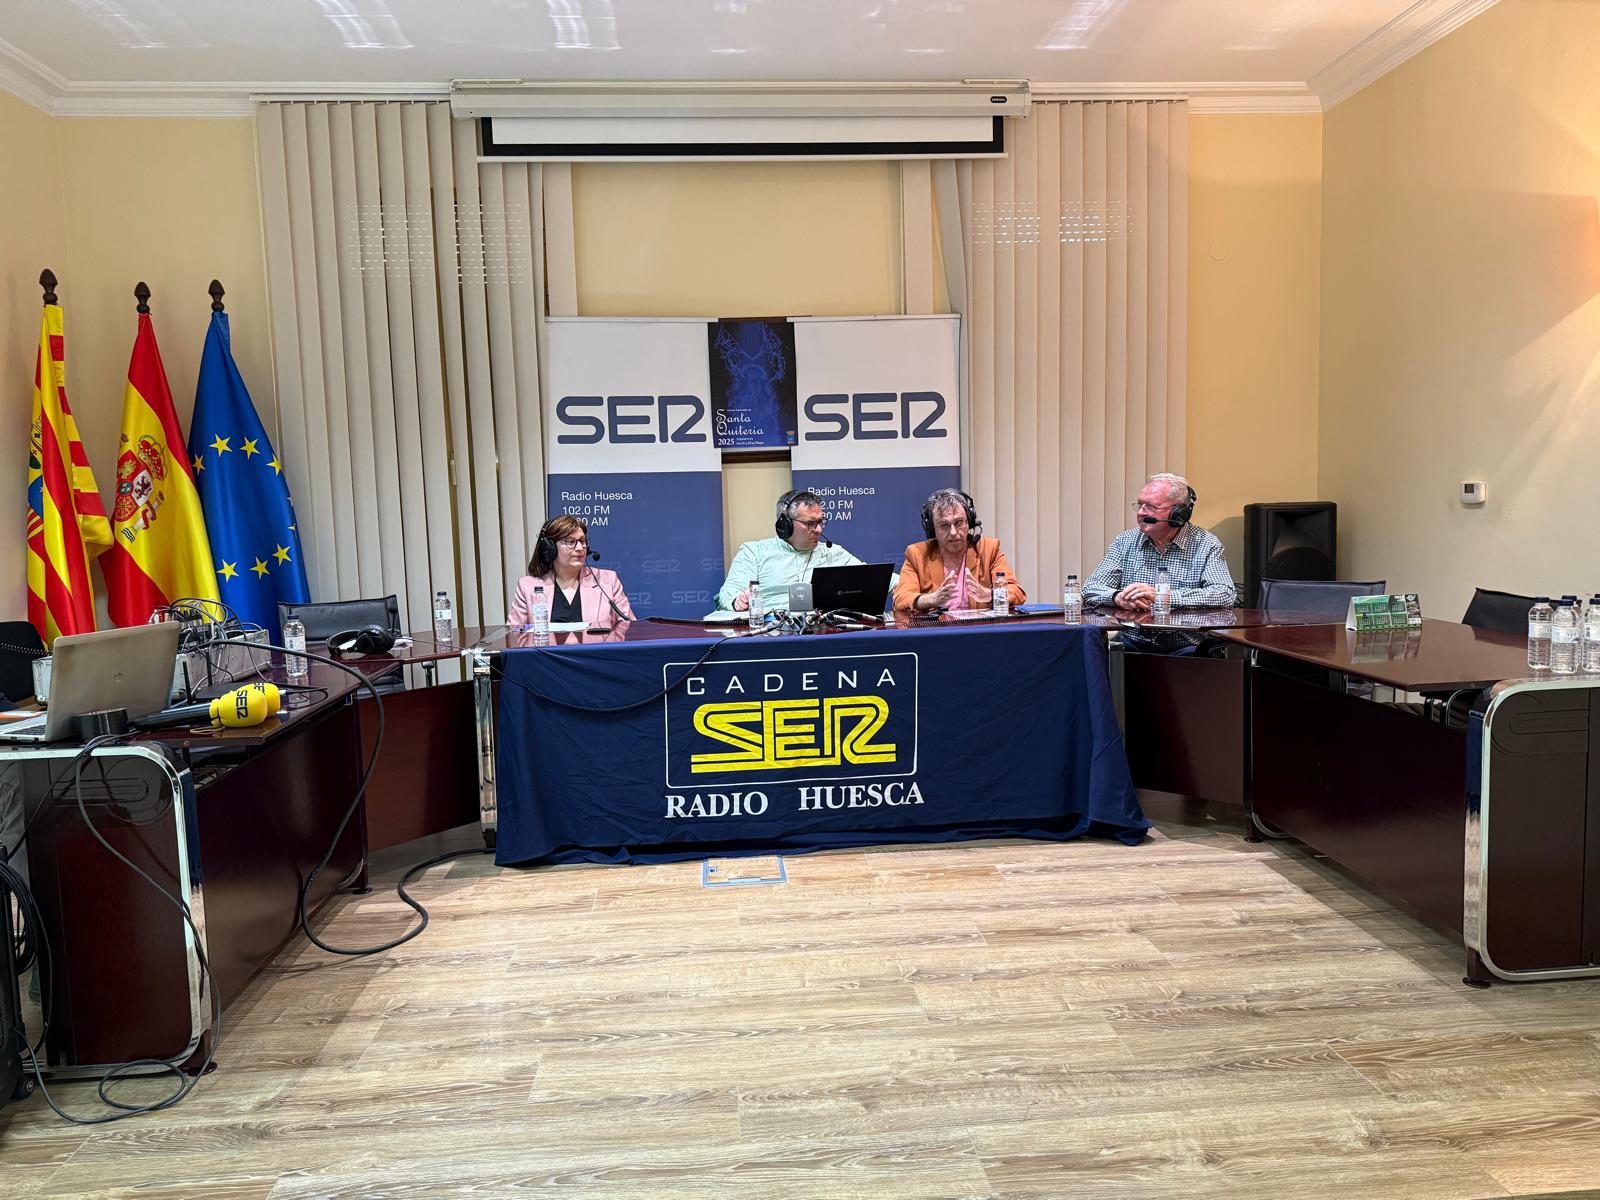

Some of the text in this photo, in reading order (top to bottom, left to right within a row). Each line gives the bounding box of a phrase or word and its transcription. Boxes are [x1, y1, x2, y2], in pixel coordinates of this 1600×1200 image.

[556, 395, 707, 444] SER
[716, 408, 752, 423] Santa
[804, 391, 947, 441] SER
[716, 421, 764, 436] Quiteria
[718, 438, 734, 446] 2025
[561, 491, 633, 501] Radio Huesca
[807, 486, 876, 496] Radio Huesca
[562, 505, 610, 515] 102.0 FM
[838, 500, 854, 510] FM
[591, 517, 609, 526] AM
[835, 511, 852, 521] AM
[642, 560, 681, 573] SER
[672, 590, 711, 604] SER
[687, 668, 896, 696] CADENA
[236, 690, 248, 719] SER
[691, 695, 896, 773] SER
[664, 781, 925, 819] RADIO HUESCA
